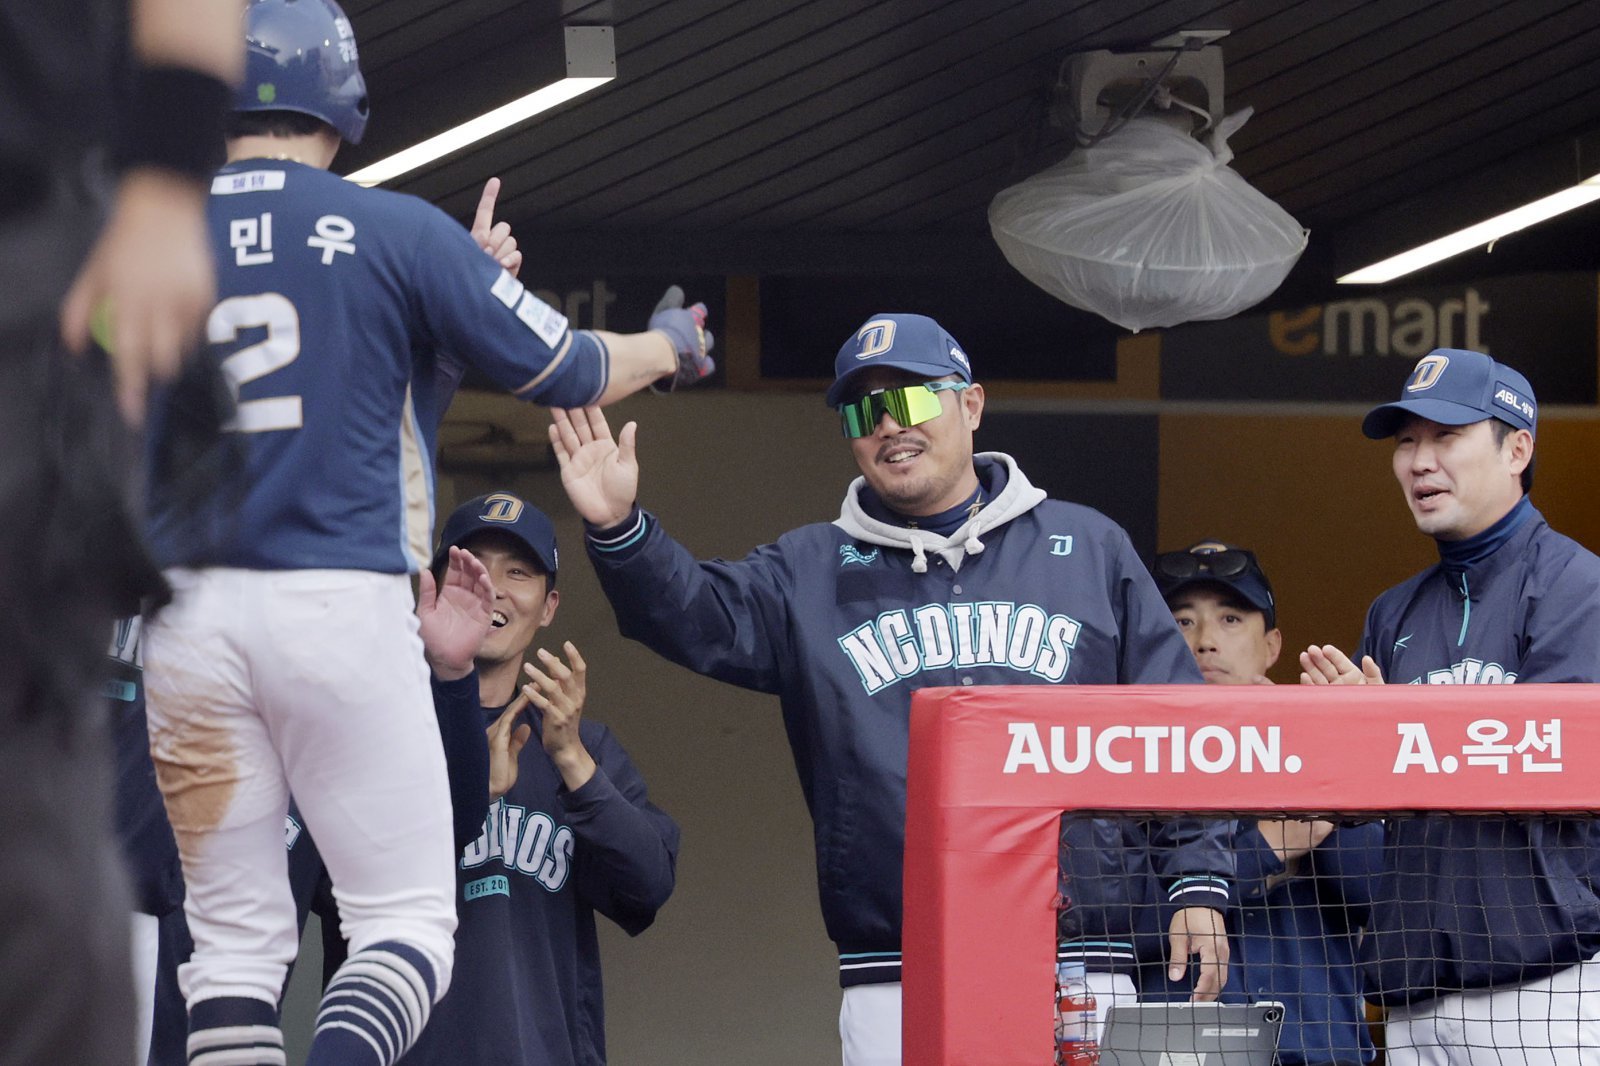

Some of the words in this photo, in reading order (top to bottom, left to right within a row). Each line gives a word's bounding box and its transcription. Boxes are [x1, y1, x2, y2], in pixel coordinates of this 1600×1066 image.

[1271, 289, 1487, 355] emart
[207, 291, 303, 433] 2
[1002, 722, 1302, 774] AUCTION.
[470, 882, 488, 895] EST.
